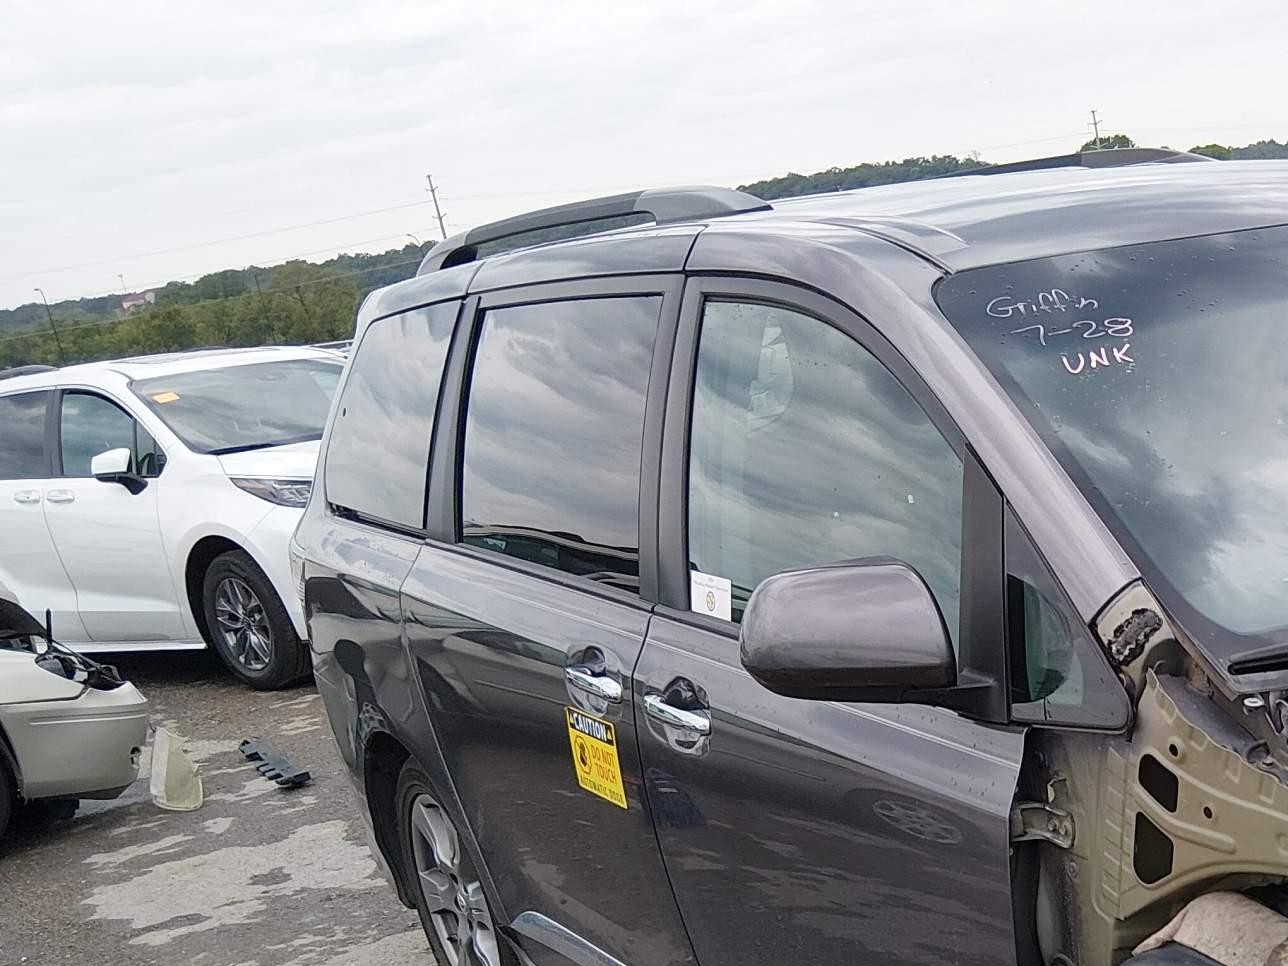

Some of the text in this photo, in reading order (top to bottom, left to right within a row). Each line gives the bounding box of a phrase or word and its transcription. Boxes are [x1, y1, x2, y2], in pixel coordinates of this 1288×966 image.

[1011, 318, 1133, 346] 7-28
[1062, 344, 1134, 374] UNK
[573, 712, 607, 741] CAUTION
